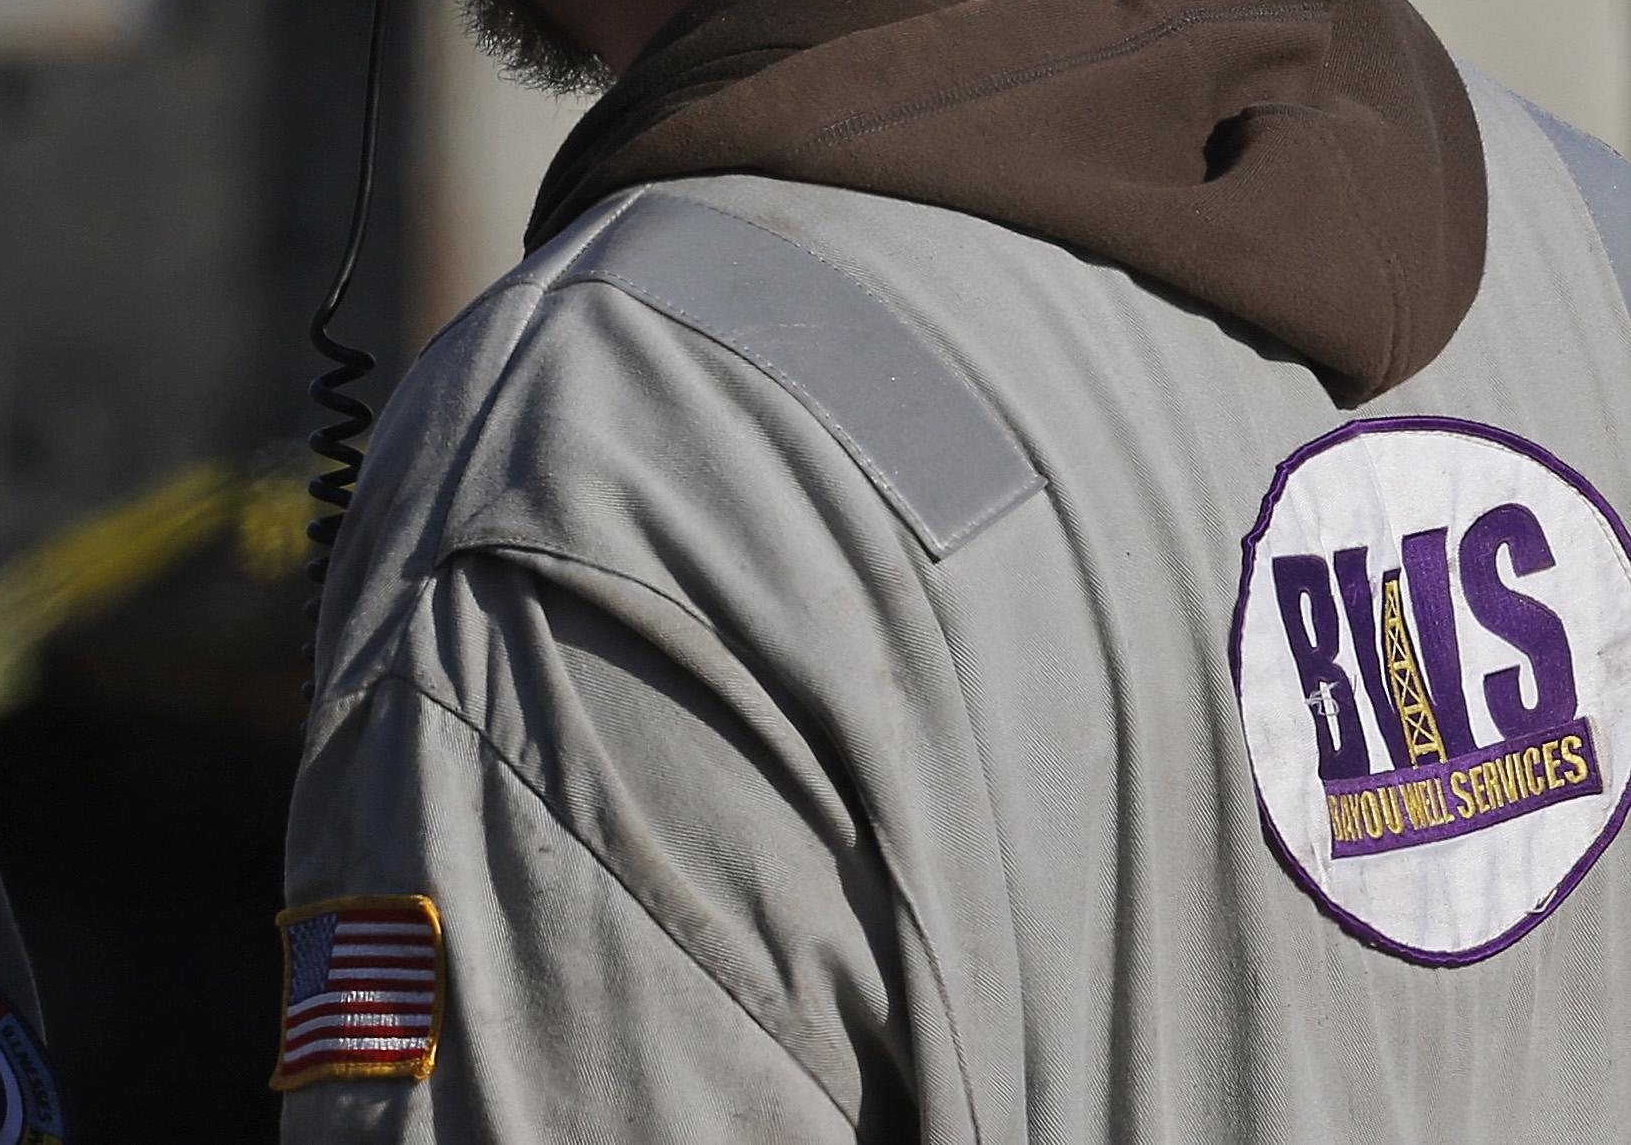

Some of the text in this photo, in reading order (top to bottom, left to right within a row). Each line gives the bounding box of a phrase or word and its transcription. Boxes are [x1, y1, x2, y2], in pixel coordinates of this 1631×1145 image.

[1272, 503, 1578, 781] BWS
[1327, 734, 1590, 841] BAYOU WELL SERVICES
